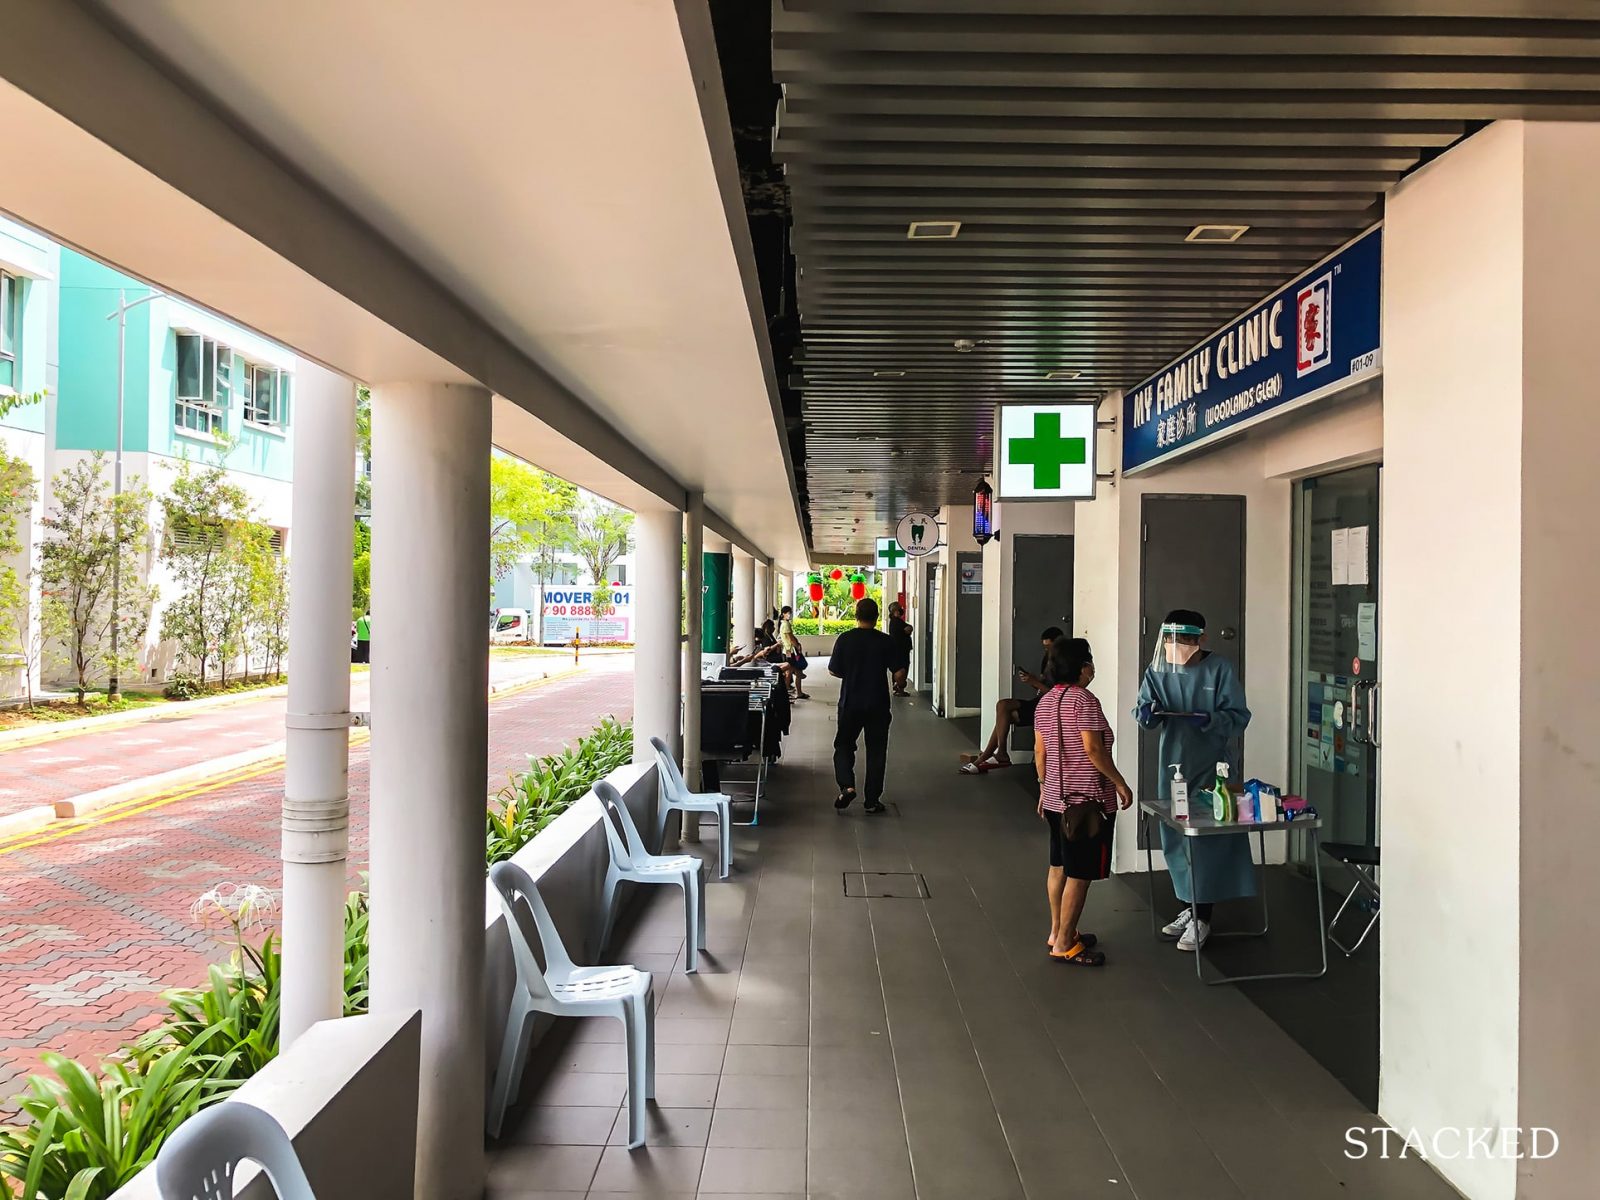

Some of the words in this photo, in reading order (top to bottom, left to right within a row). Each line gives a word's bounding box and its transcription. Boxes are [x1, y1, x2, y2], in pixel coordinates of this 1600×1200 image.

[1133, 385, 1153, 429] MY
[1156, 347, 1211, 415] FAMILY
[1216, 300, 1283, 379] CLINIC
[1351, 354, 1374, 373] #01-09
[1205, 390, 1255, 429] (WOODLANDS
[1256, 372, 1283, 403] GLEN)
[543, 592, 598, 604] MOVER
[552, 606, 567, 616] 90
